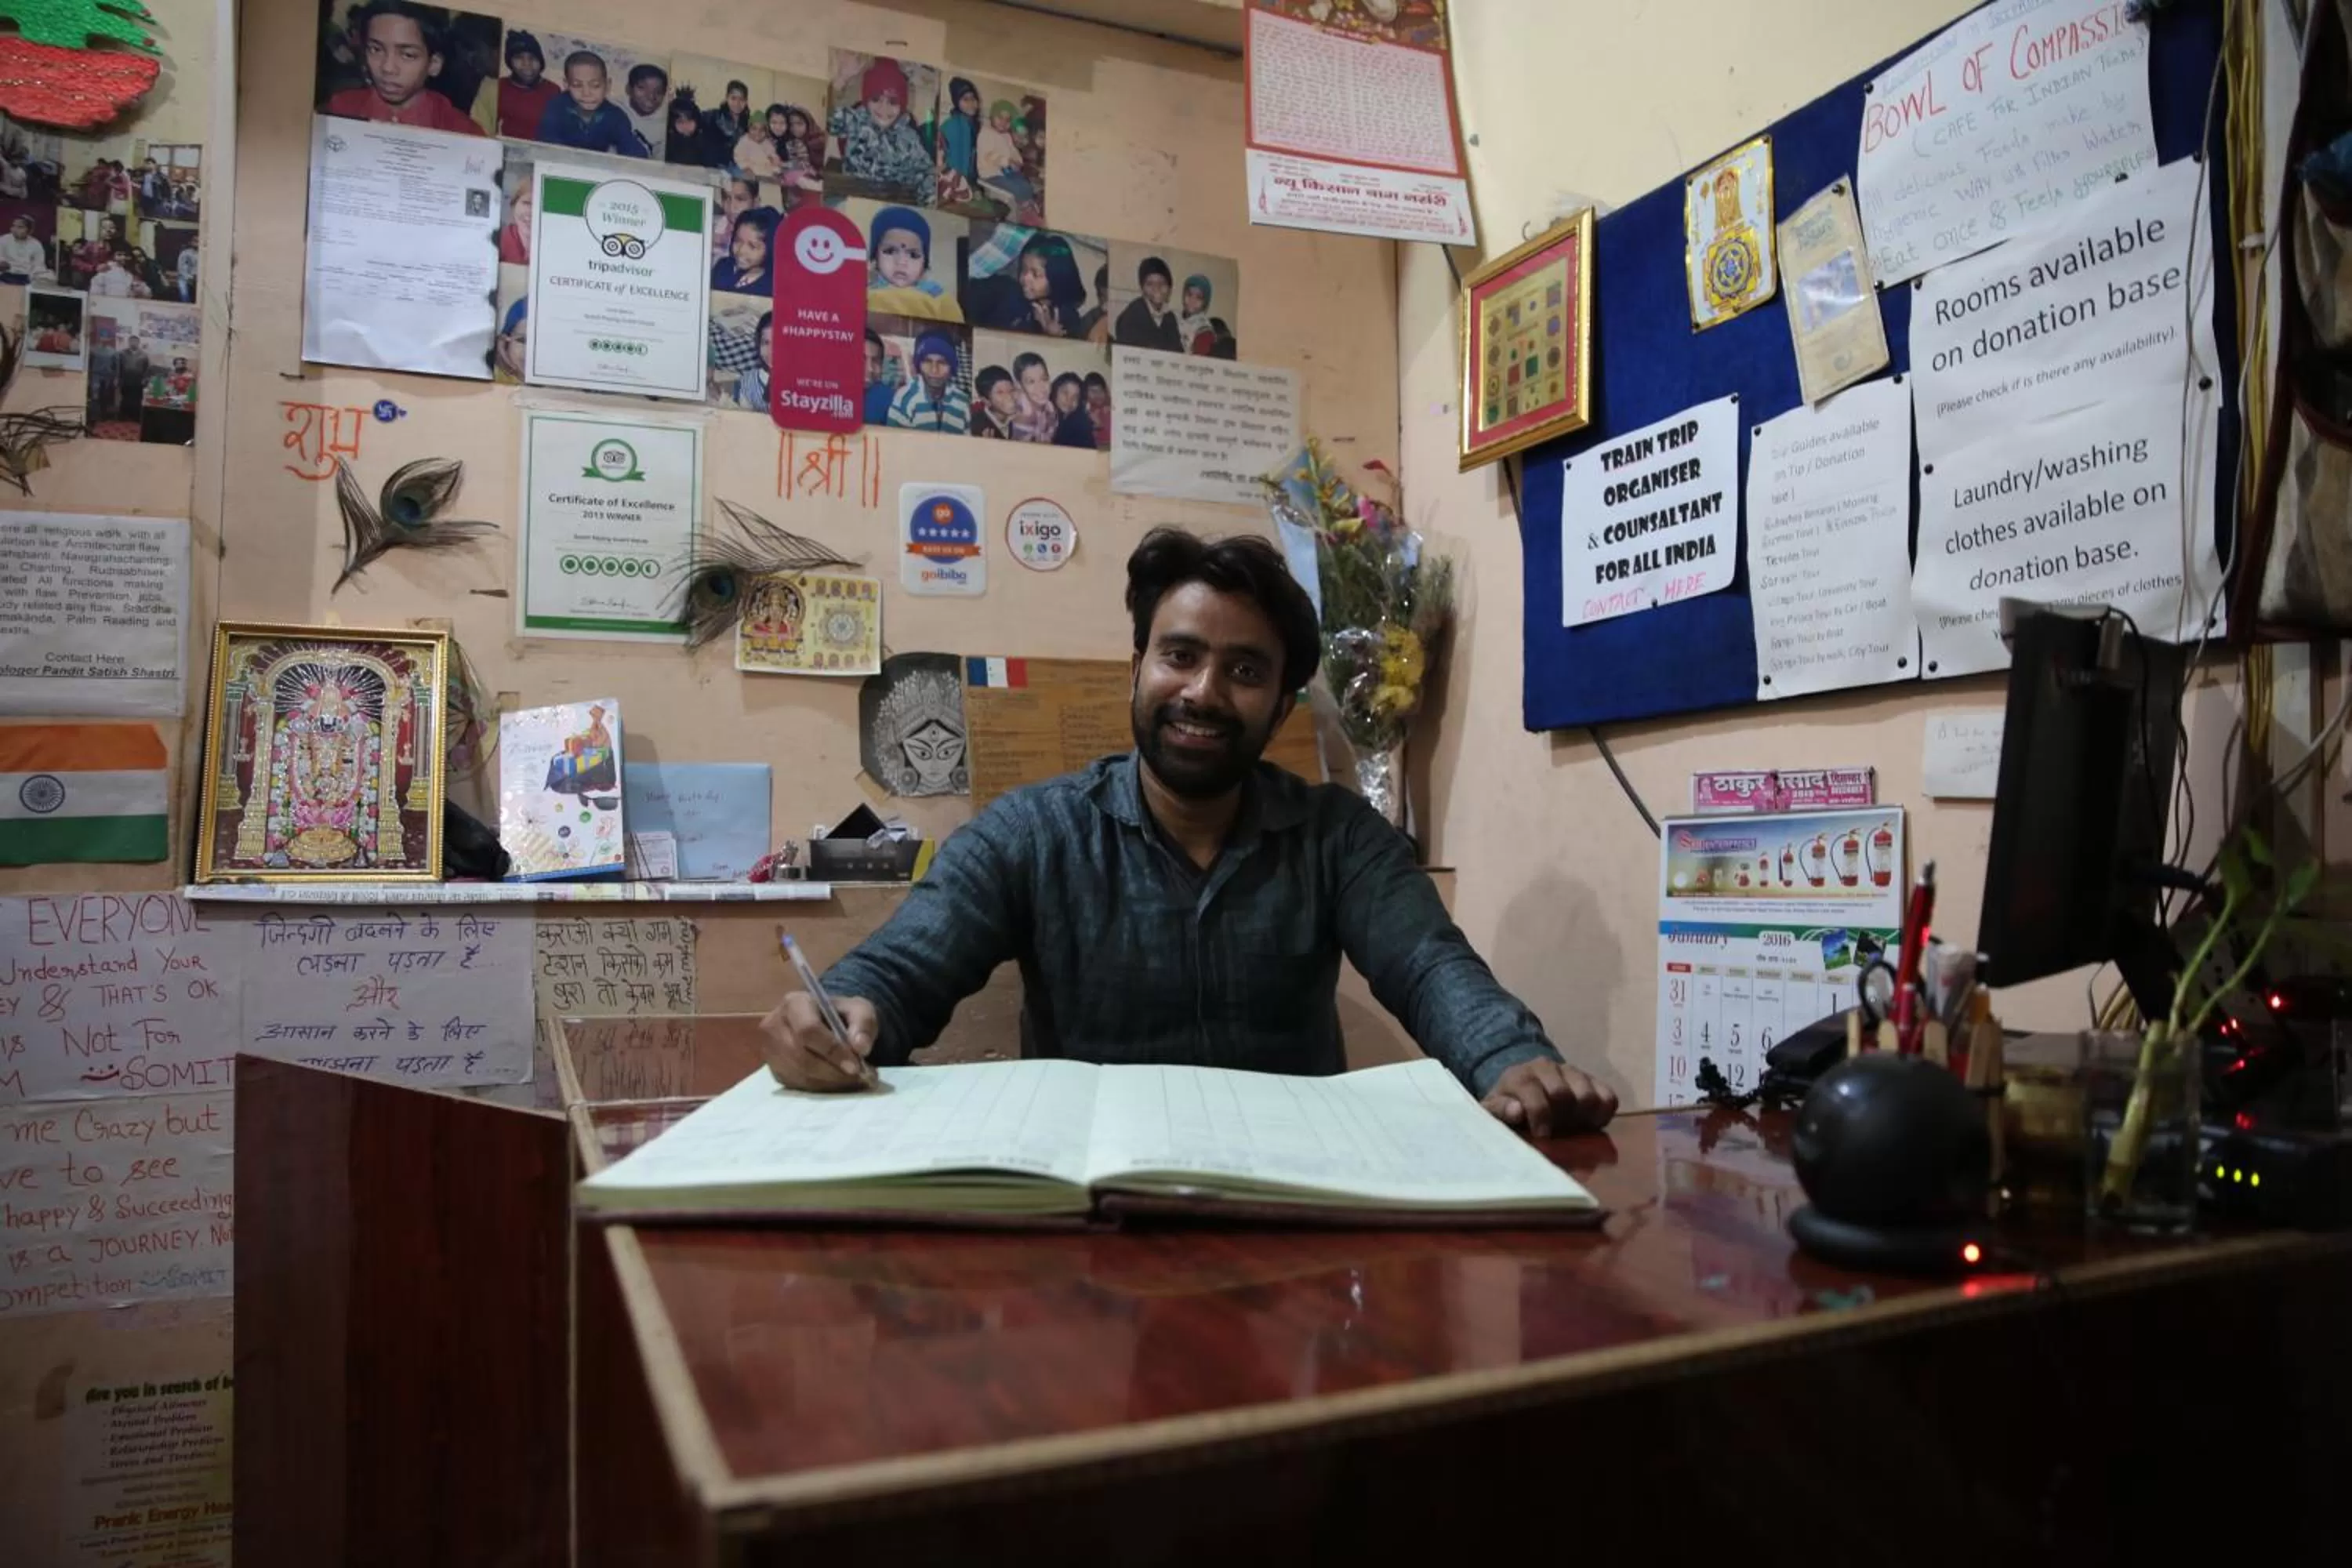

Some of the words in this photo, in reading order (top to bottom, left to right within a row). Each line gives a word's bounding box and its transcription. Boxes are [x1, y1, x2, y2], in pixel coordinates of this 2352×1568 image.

[1865, 71, 1947, 154] BOWL
[1962, 42, 1993, 93] OF
[588, 260, 655, 277] tripadvisor
[1934, 274, 2022, 326] Rooms
[2028, 217, 2166, 289] available
[550, 276, 612, 292] CERTIFICATE
[630, 286, 690, 302] EXCELLENCE
[797, 309, 829, 322] HAVE
[829, 313, 840, 324] A
[1931, 344, 1964, 373] on
[1972, 297, 2096, 359] donation
[2107, 265, 2182, 313] base
[1974, 378, 2009, 410] check
[2035, 365, 2071, 386] there
[2072, 355, 2098, 376] any
[780, 390, 855, 414] Stayzilla
[1600, 437, 1653, 473] TRAIN
[1657, 419, 1700, 453] TRIP
[1814, 446, 1866, 470] Donation
[1603, 458, 1702, 507] ORGANISER
[1952, 437, 2151, 510] Laundry/washing
[549, 493, 605, 507] Certificate
[607, 497, 619, 508] of
[620, 498, 676, 511] Excellence
[1018, 520, 1062, 541] ixigo
[1587, 533, 1599, 551] &
[1603, 492, 1723, 545] COUNSALTANT
[1944, 519, 2018, 556] clothes
[2023, 489, 2126, 536] available
[2132, 481, 2168, 508] on
[920, 567, 967, 582] goibibo
[1595, 559, 1630, 585] FOR
[1632, 549, 1662, 575] ALL
[1664, 534, 1717, 566] INDIA
[1969, 555, 2070, 592] donation
[2074, 539, 2140, 570] base.
[2132, 574, 2183, 593] clothes
[45, 652, 93, 663] Contact
[96, 653, 125, 664] Here
[28, 895, 211, 946] EVERYONE
[1762, 932, 1792, 947] 2016
[88, 983, 169, 1008] THAT'S
[187, 979, 219, 1000] OK
[1668, 978, 1686, 1003] 31
[62, 1022, 122, 1058] Not
[1700, 1021, 1711, 1044] 4
[1730, 1022, 1740, 1047] 5
[1761, 1025, 1773, 1054] 6
[165, 1103, 224, 1135] but
[56, 1150, 104, 1186] to
[85, 1386, 111, 1404] Are
[114, 1385, 140, 1403] you
[143, 1380, 158, 1399] in
